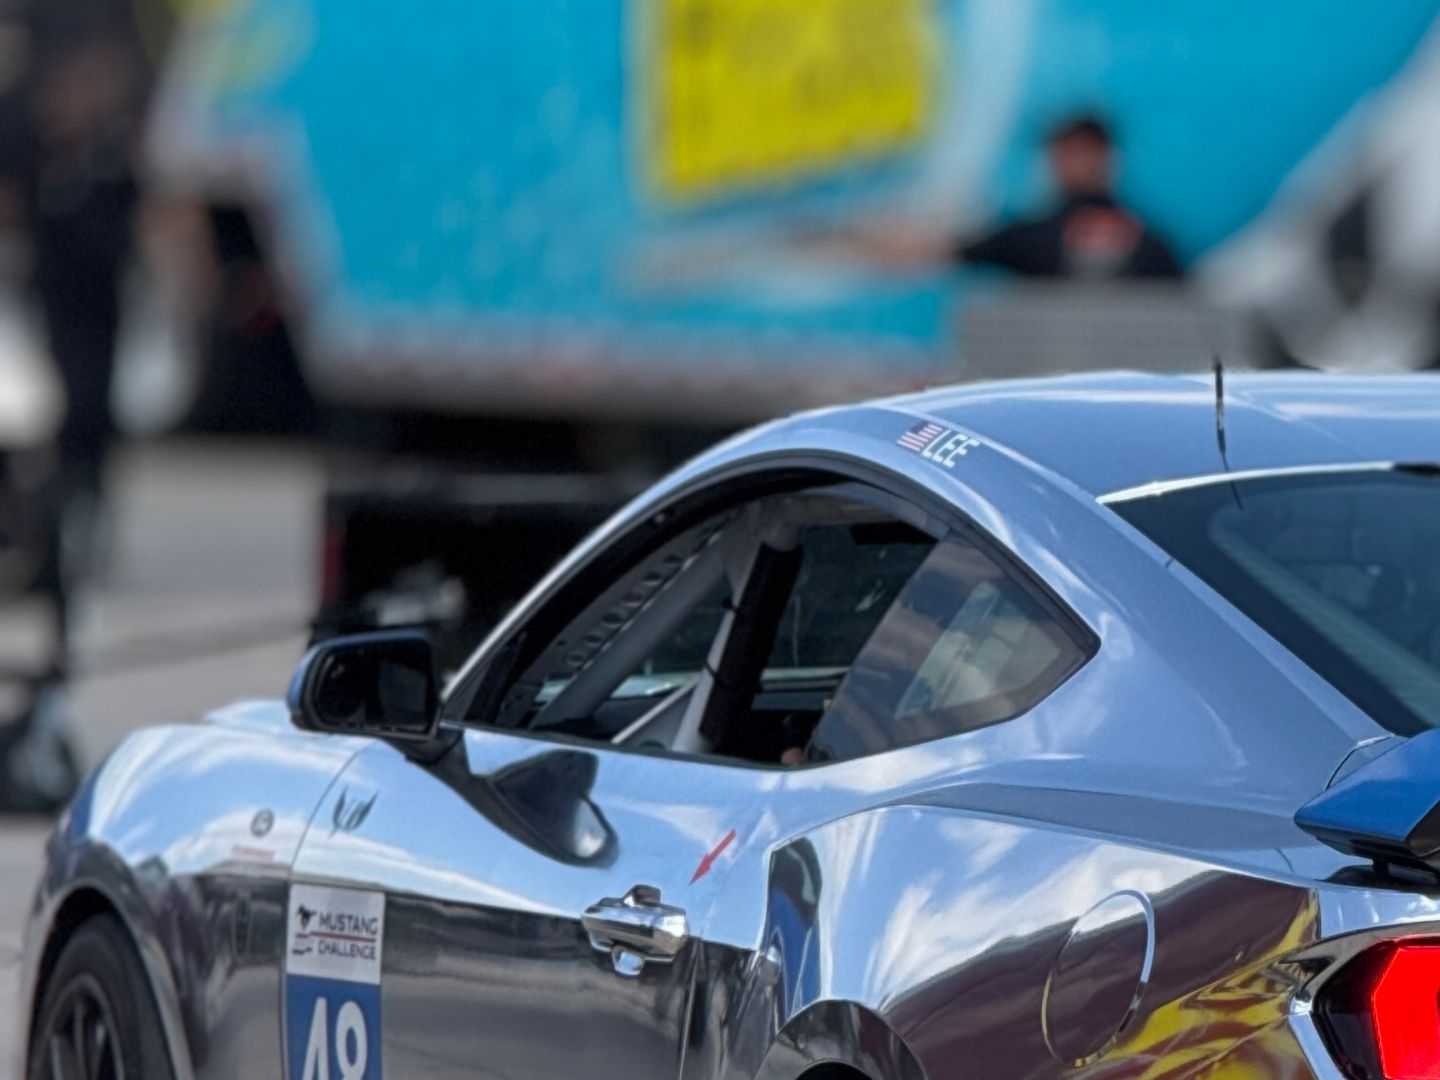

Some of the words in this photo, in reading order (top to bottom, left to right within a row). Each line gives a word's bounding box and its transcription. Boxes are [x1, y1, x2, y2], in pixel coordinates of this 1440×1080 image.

[922, 430, 980, 467] LEE
[319, 912, 378, 935] MUSTANG
[318, 940, 377, 961] CHALLENGE
